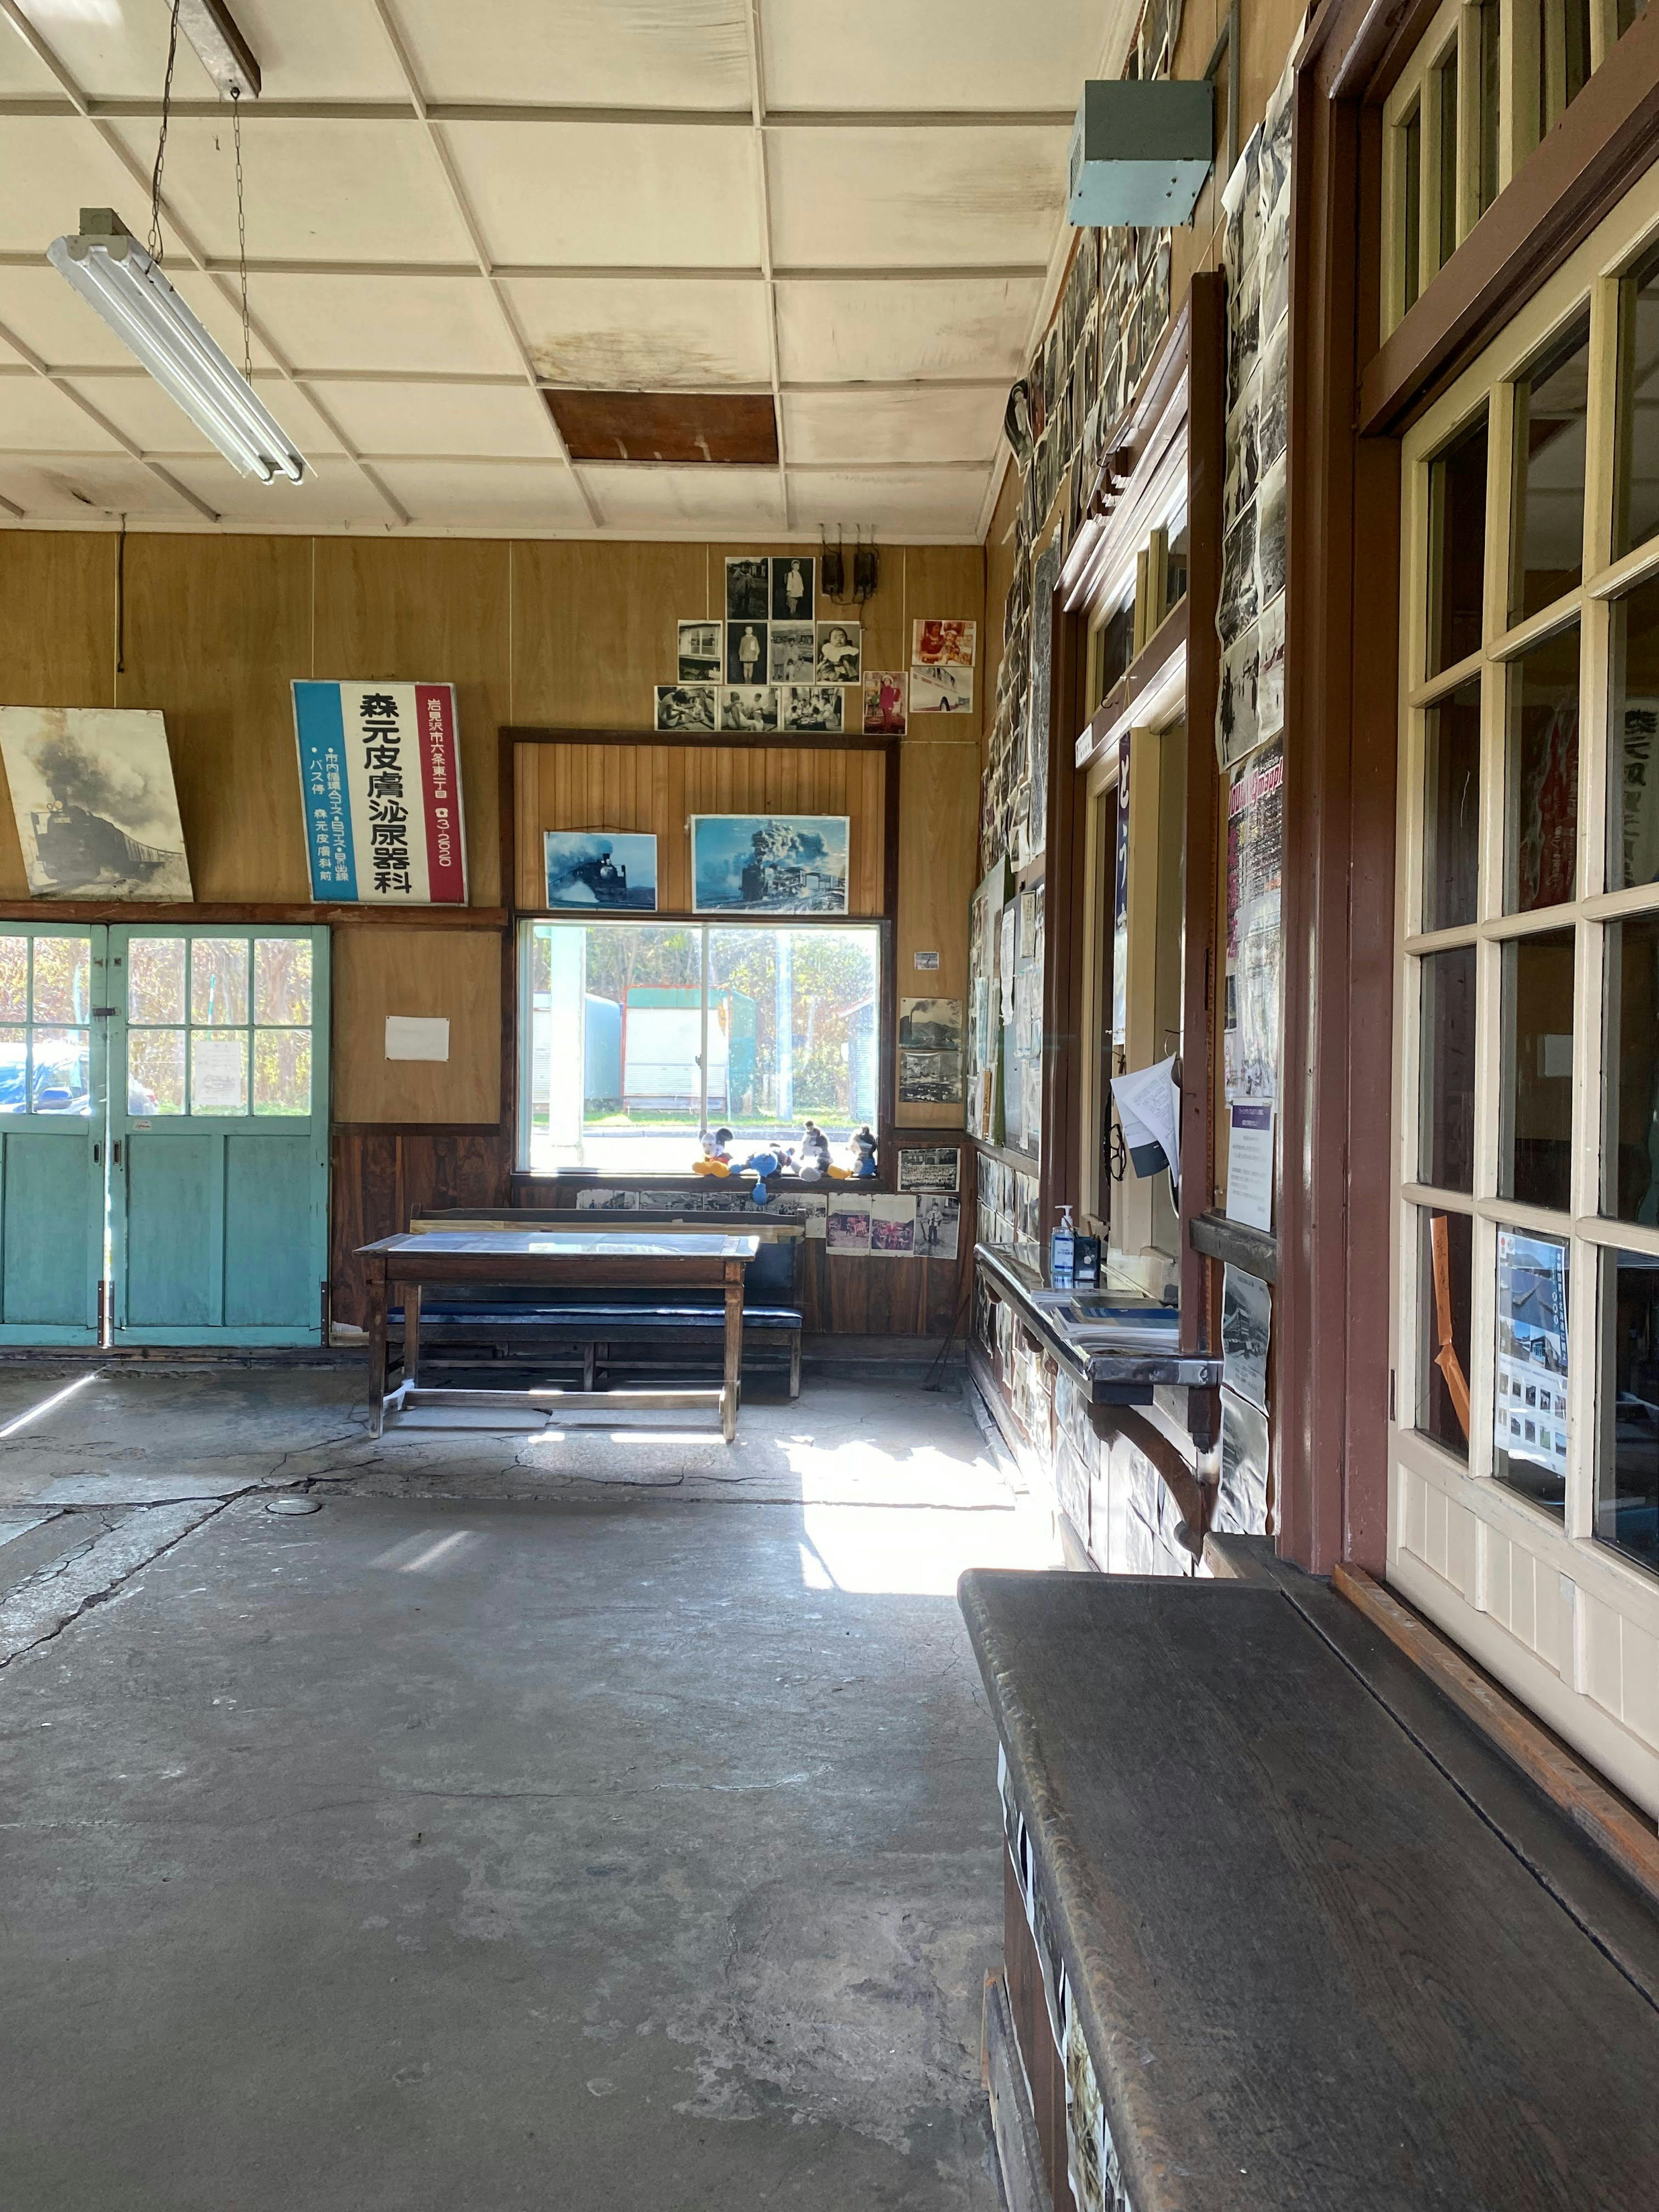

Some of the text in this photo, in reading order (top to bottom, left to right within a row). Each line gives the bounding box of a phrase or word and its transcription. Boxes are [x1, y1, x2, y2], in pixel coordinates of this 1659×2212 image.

[359, 693, 412, 894] 森元皮膚泌尿器科
[427, 698, 448, 799] 岩見沢市六条東一丁目
[309, 760, 332, 881] バス停 森元皮膚科前
